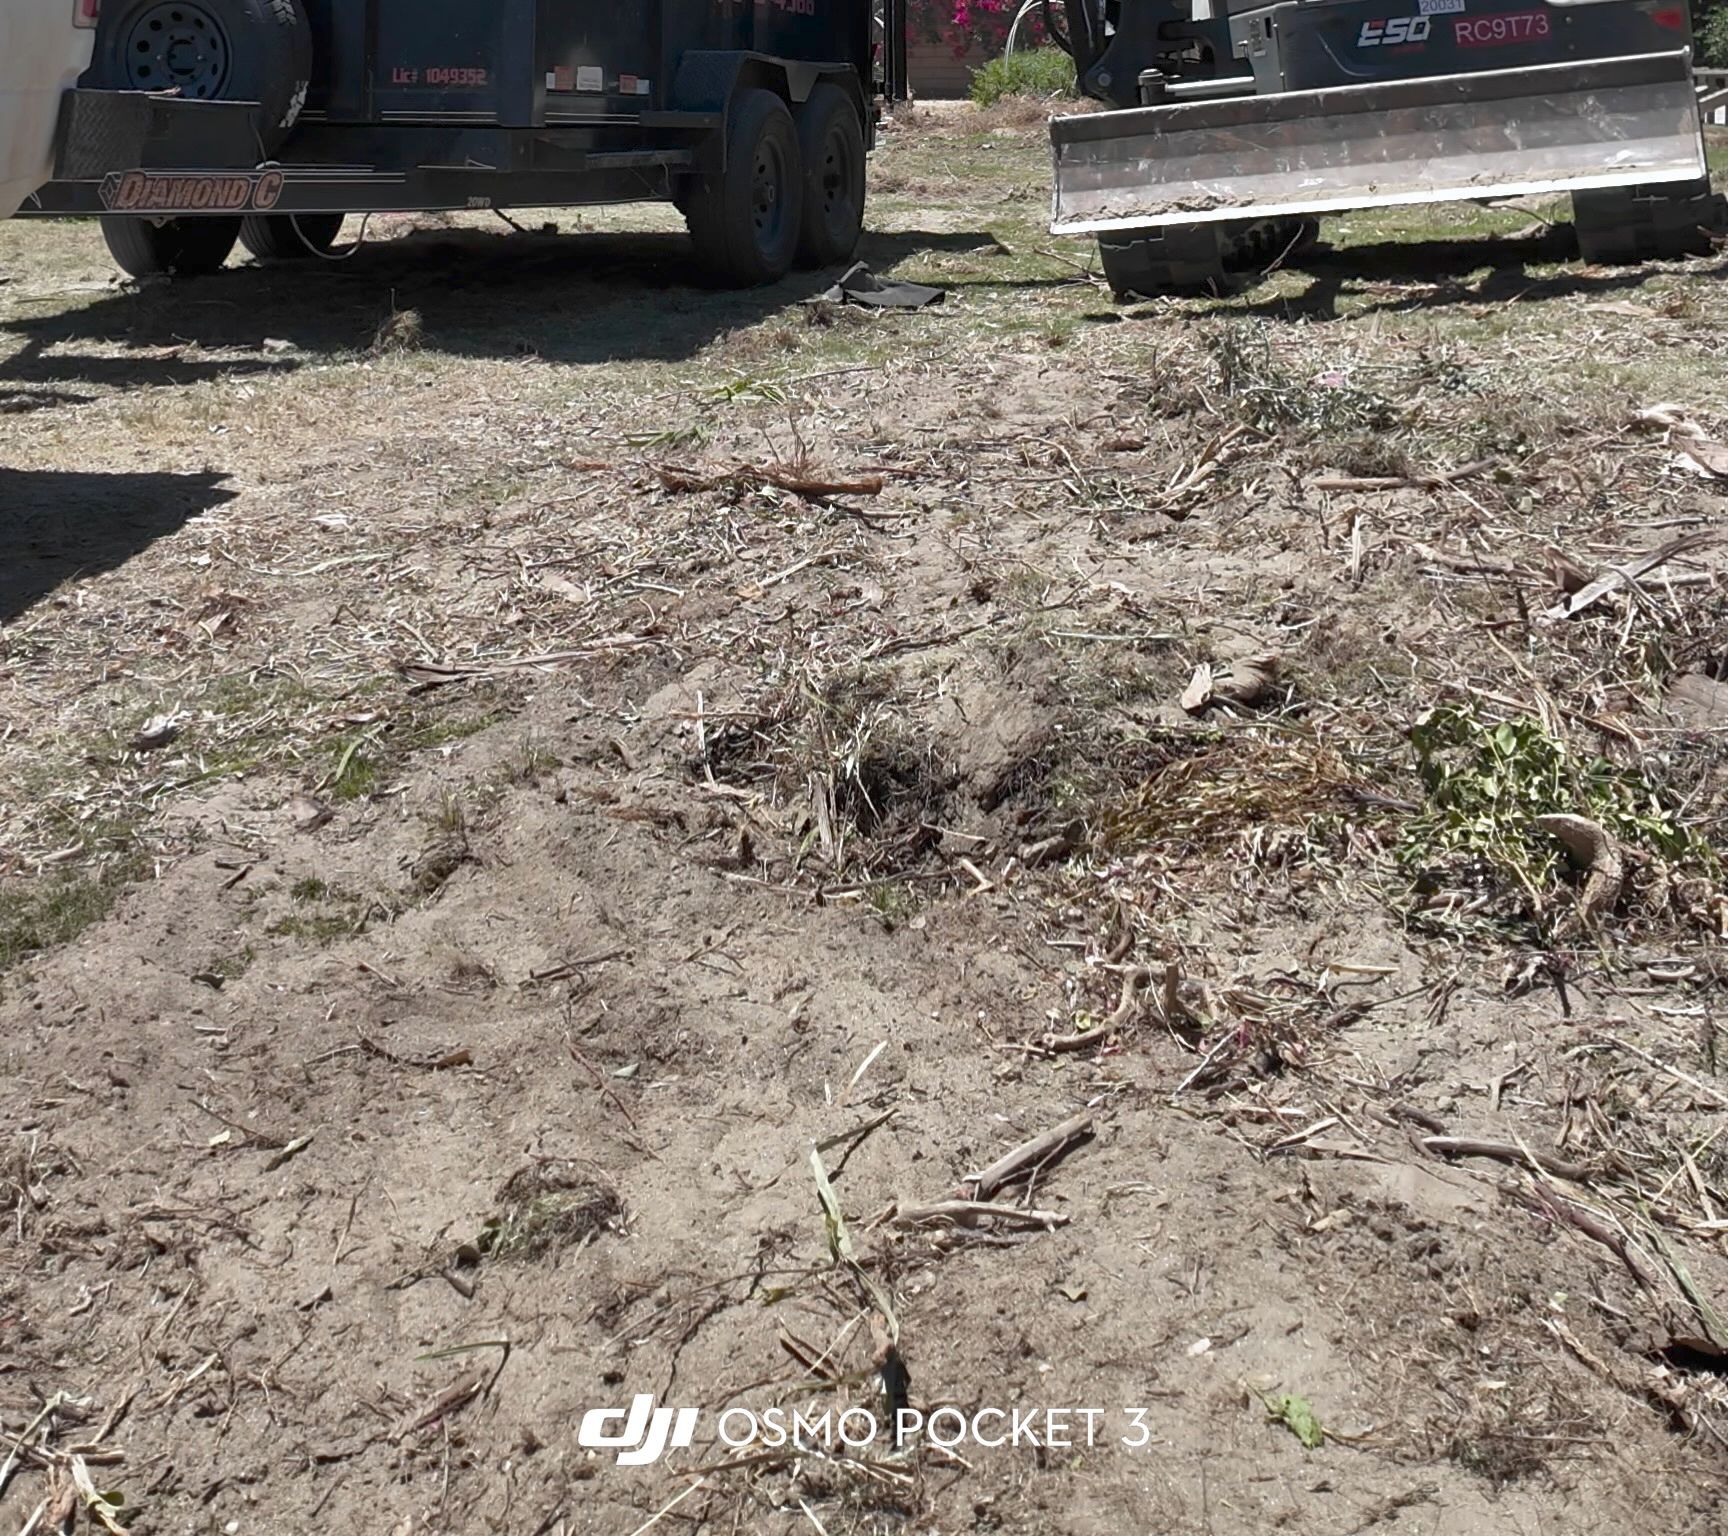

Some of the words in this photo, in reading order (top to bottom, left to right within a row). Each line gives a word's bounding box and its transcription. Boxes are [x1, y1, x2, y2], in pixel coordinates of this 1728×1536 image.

[1455, 14, 1549, 43] RC9T73
[426, 67, 488, 85] 1049352
[114, 170, 250, 210] DIAMOND
[253, 171, 283, 209] C
